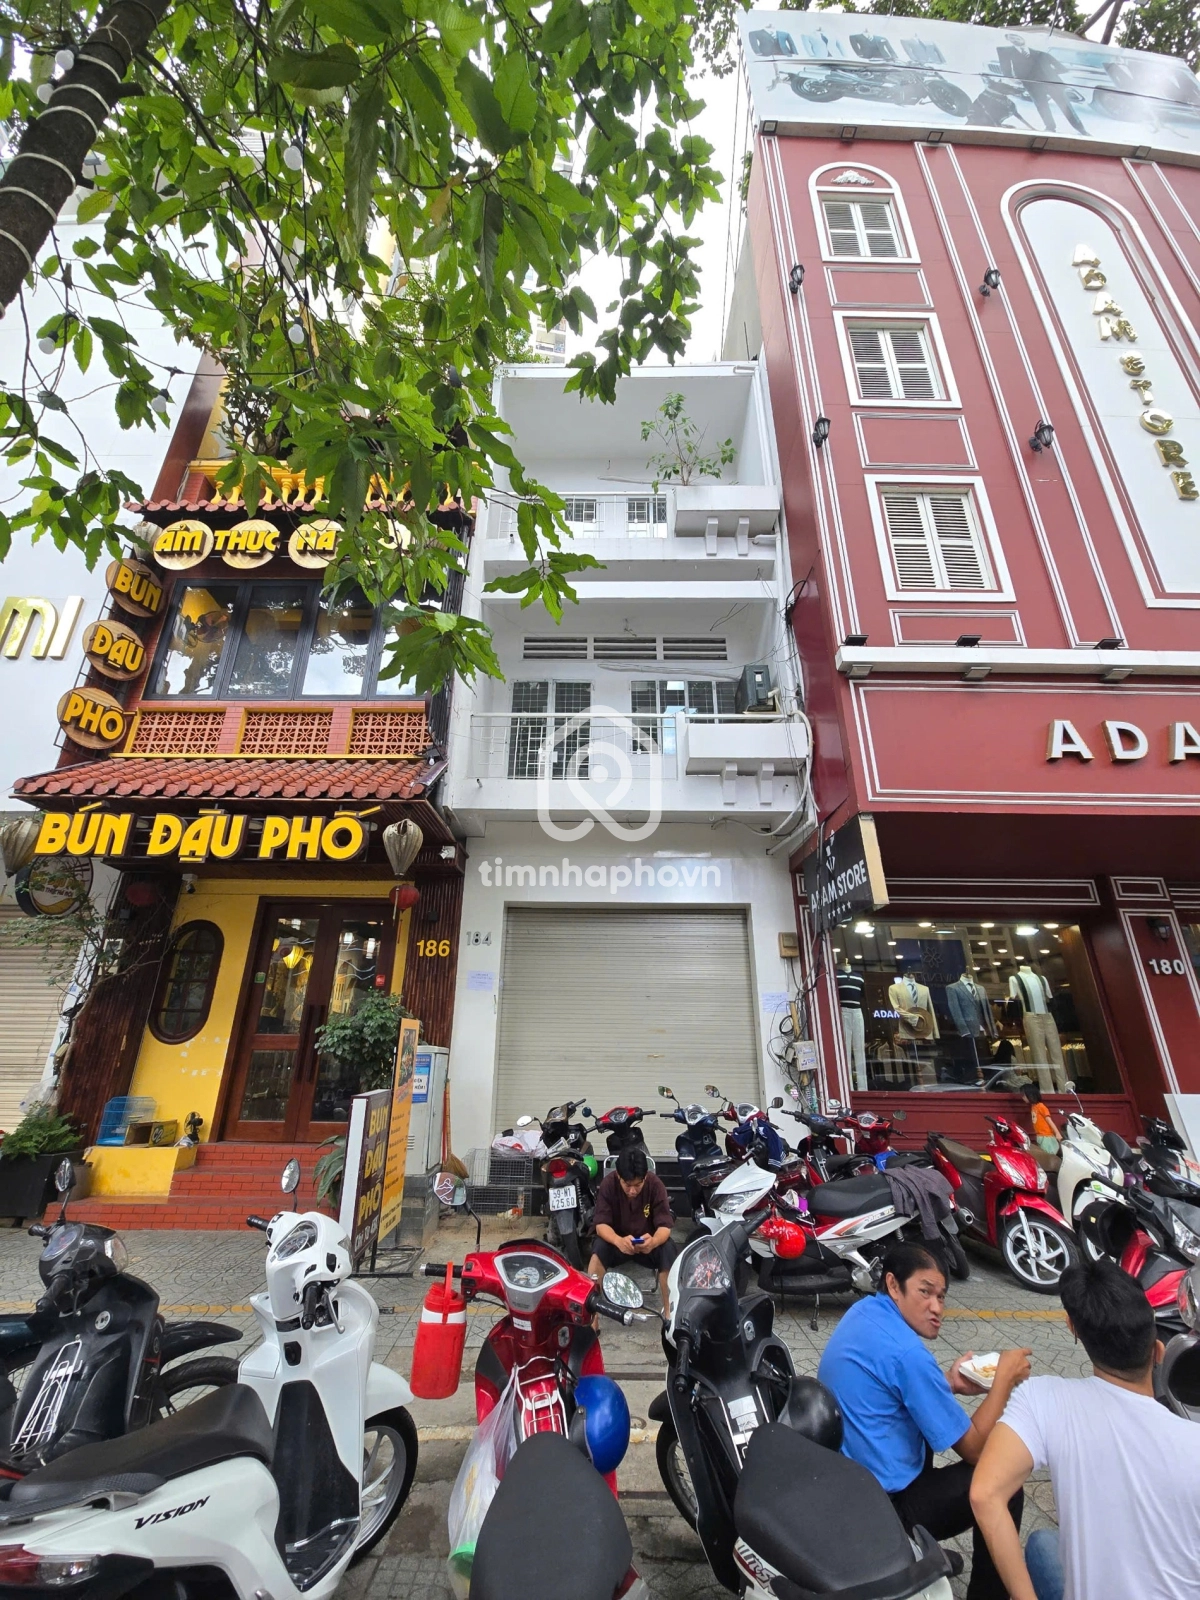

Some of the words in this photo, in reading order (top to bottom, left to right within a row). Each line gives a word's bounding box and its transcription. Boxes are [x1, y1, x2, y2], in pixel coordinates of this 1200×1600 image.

[1072, 244, 1138, 342] ADAM
[1119, 351, 1199, 501] STORE
[114, 564, 162, 612] BÚN
[34, 801, 131, 854] BÚN
[147, 809, 246, 863] ĐẬU
[259, 804, 382, 861] PHỐ
[836, 859, 867, 897] STORE
[416, 939, 451, 957] 186
[466, 931, 492, 946] 184
[1149, 958, 1185, 975] 180
[134, 1495, 211, 1530] VISION
